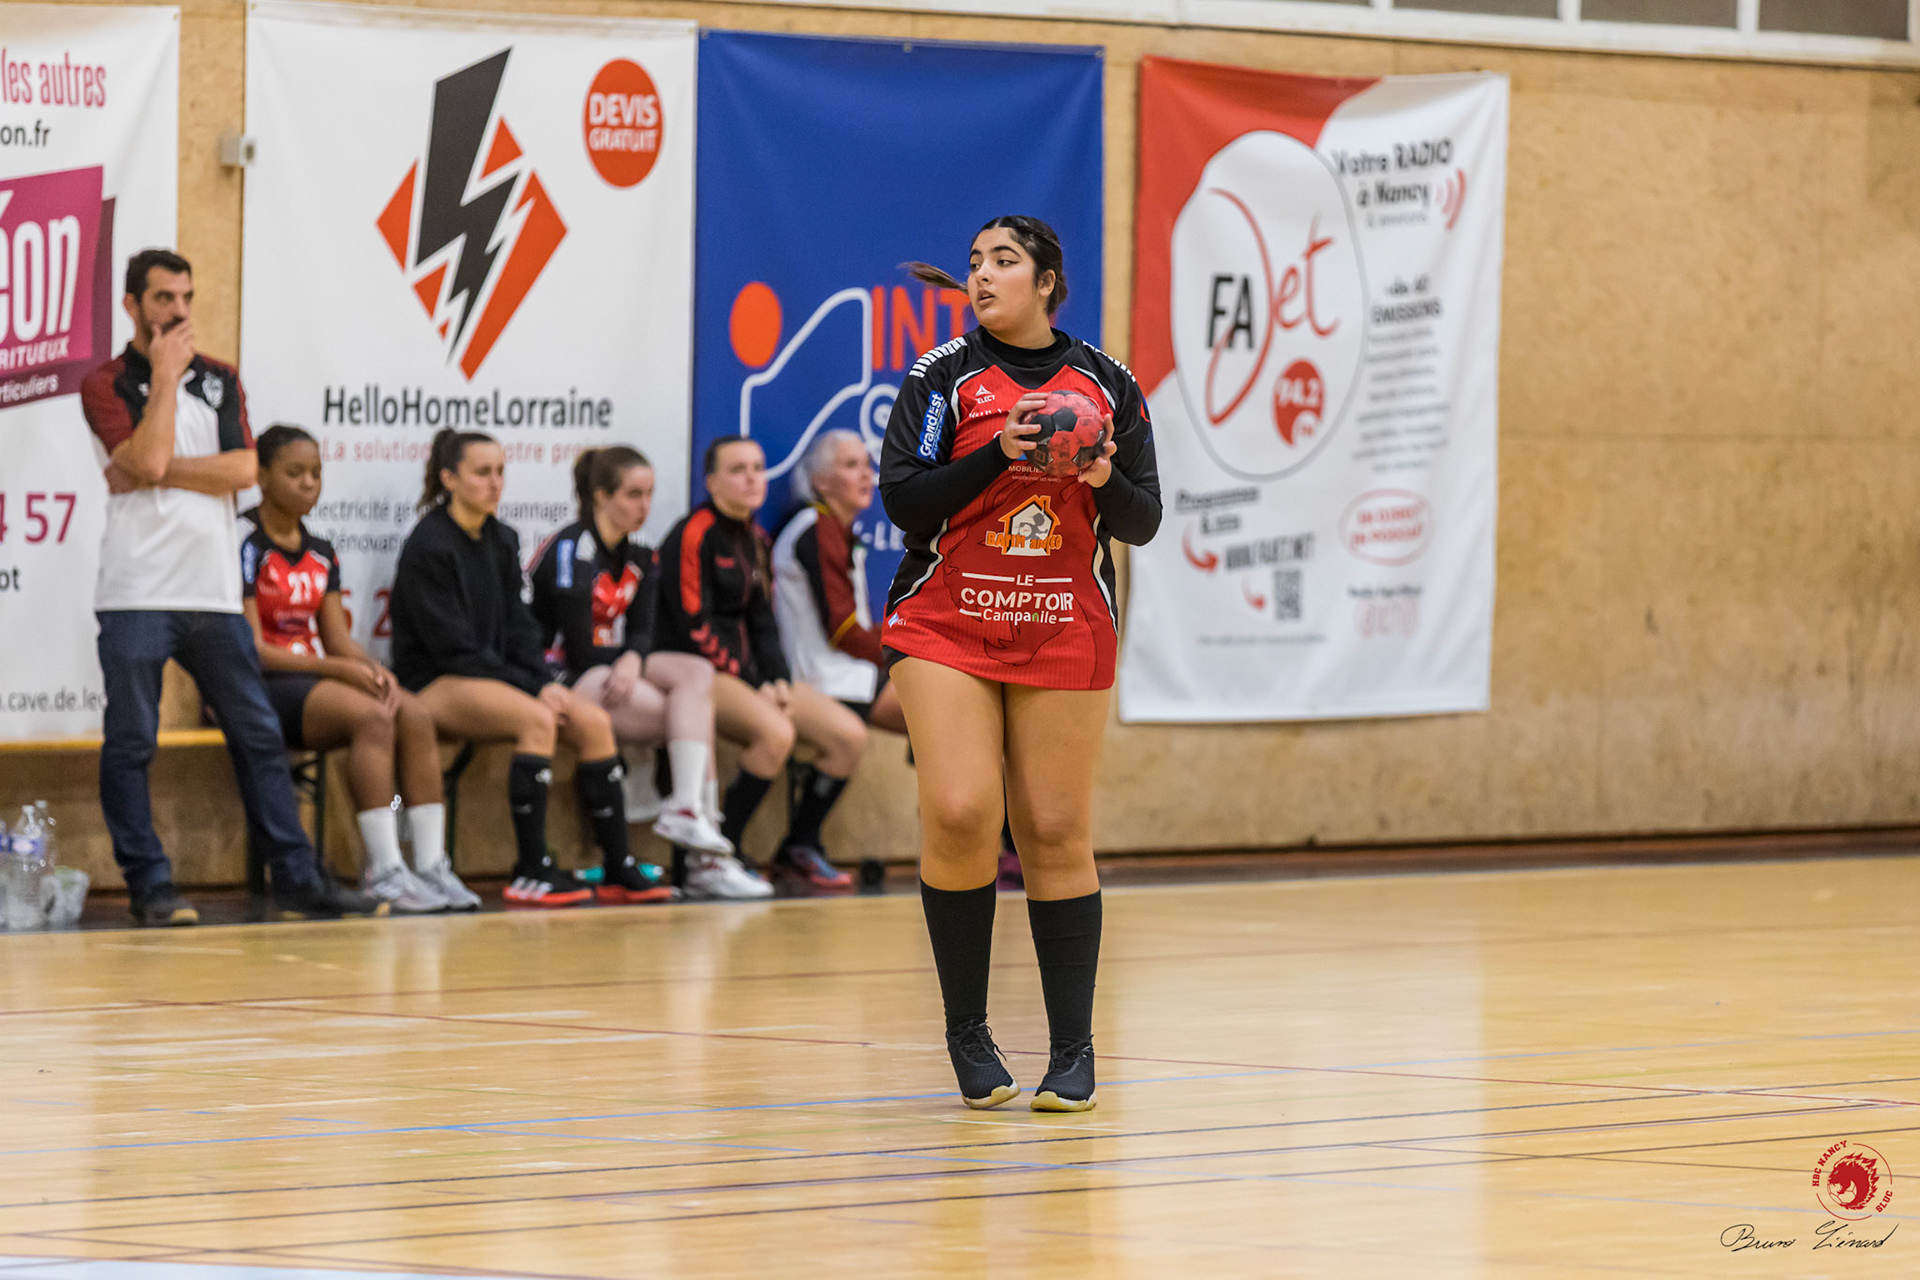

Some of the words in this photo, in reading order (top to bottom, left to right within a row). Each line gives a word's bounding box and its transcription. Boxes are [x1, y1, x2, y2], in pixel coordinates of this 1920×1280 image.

[1, 48, 32, 102] les
[39, 51, 107, 108] autres
[588, 93, 659, 127] DEVIS
[588, 128, 658, 153] GRATUIT
[1394, 136, 1453, 171] RADIO
[1375, 179, 1430, 210] Nancy
[0, 190, 80, 346] on
[323, 385, 613, 428] HelloHomeLorraine
[322, 437, 346, 462] La
[503, 439, 544, 463] otre
[25, 492, 77, 544] 57
[316, 496, 390, 521] lectricité
[1016, 574, 1035, 587] LE
[960, 587, 1074, 611] COMPTOIR
[983, 608, 1058, 626] Campanile
